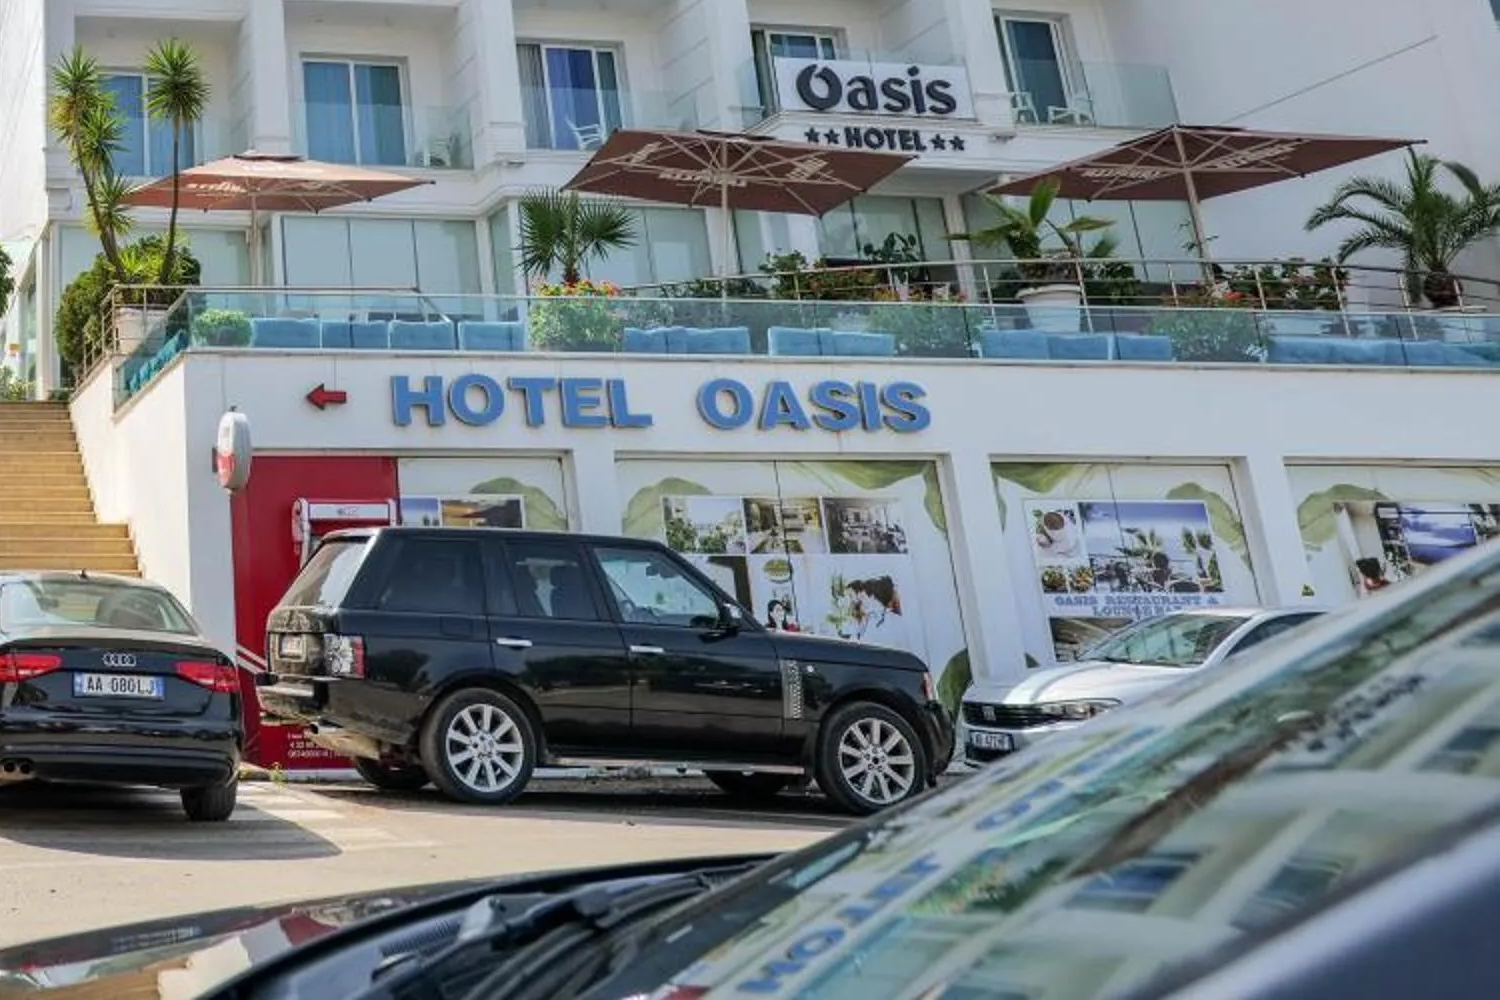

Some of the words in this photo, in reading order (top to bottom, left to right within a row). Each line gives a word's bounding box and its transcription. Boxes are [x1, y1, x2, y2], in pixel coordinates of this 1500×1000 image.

[795, 64, 958, 115] Oasis
[844, 126, 927, 152] HOTEL
[389, 373, 654, 429] HOTEL
[696, 377, 933, 433] OASIS
[1054, 594, 1098, 607] OASIS
[1105, 594, 1203, 608] RESTAURANT
[87, 675, 103, 692] AA
